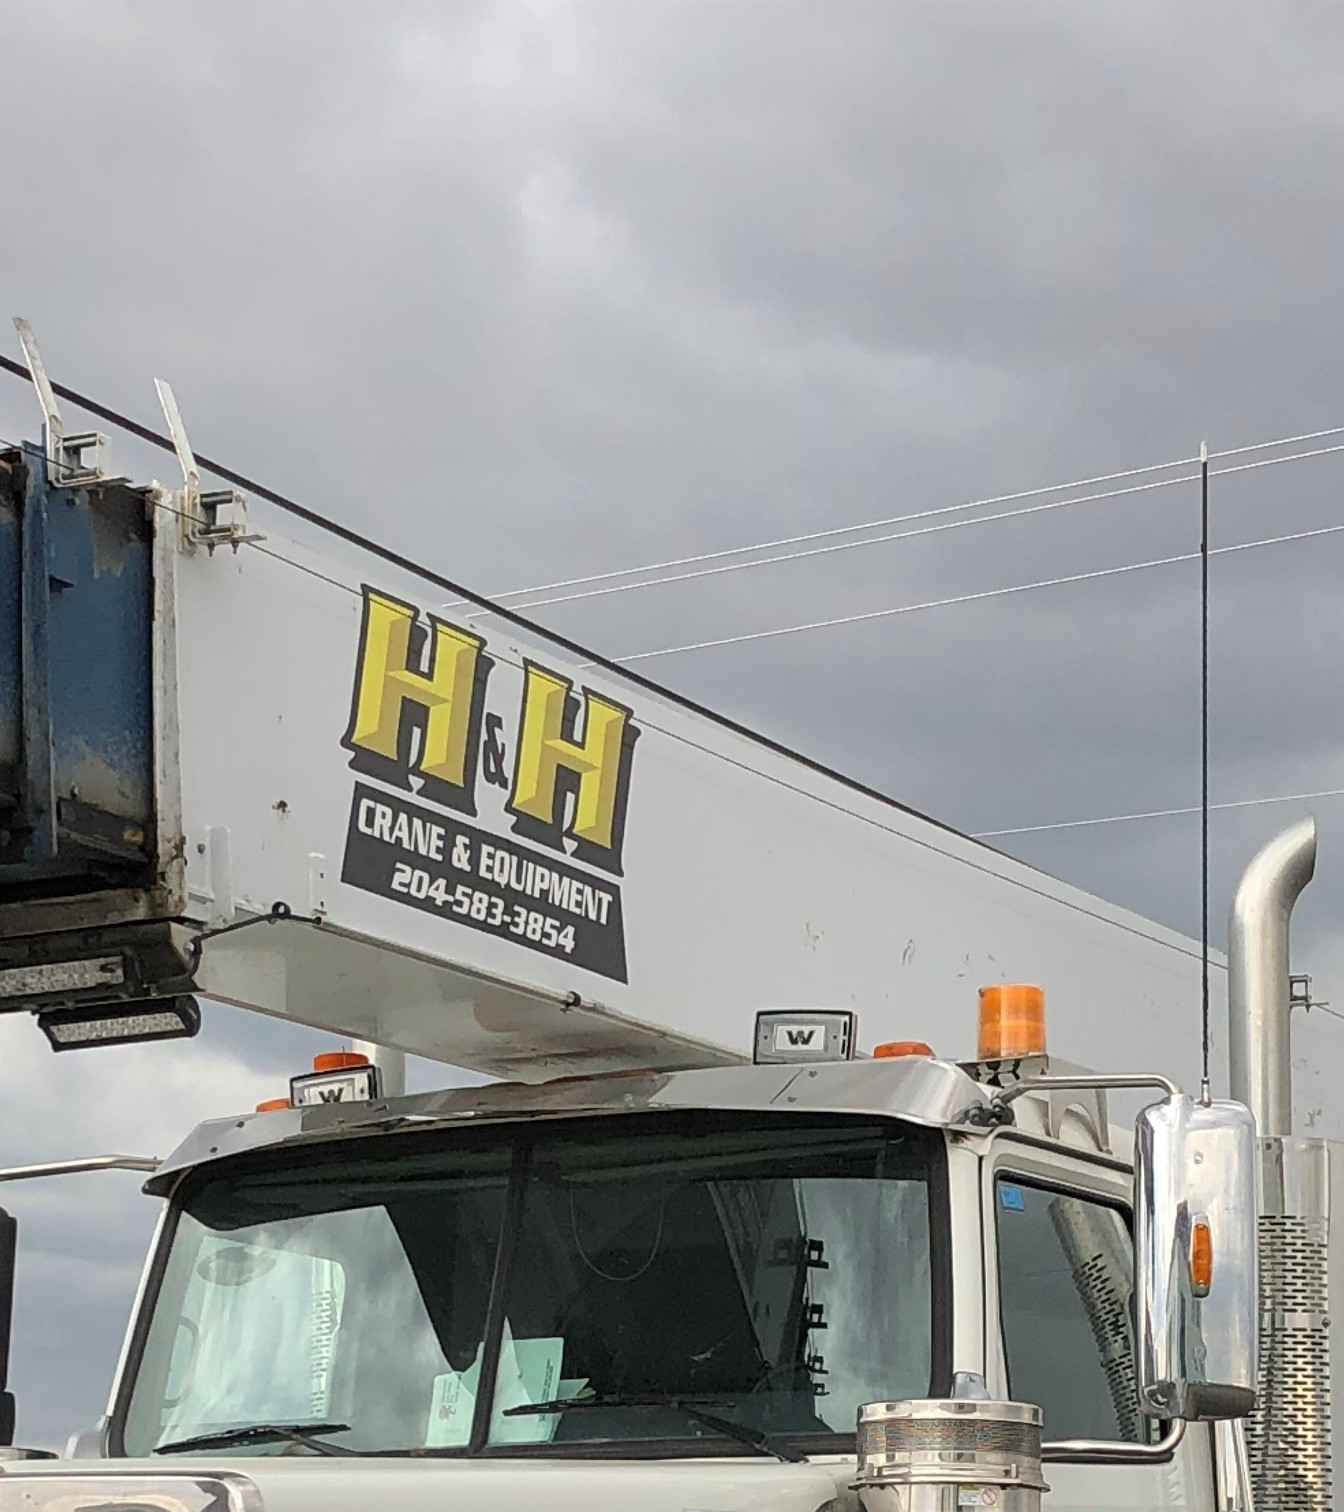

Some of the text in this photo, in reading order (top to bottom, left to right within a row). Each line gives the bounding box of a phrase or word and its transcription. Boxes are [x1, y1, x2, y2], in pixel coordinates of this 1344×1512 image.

[358, 798, 613, 926] CRANE & EQUIPMENT
[390, 861, 576, 954] 204-583-3854
[786, 1030, 815, 1046] W
